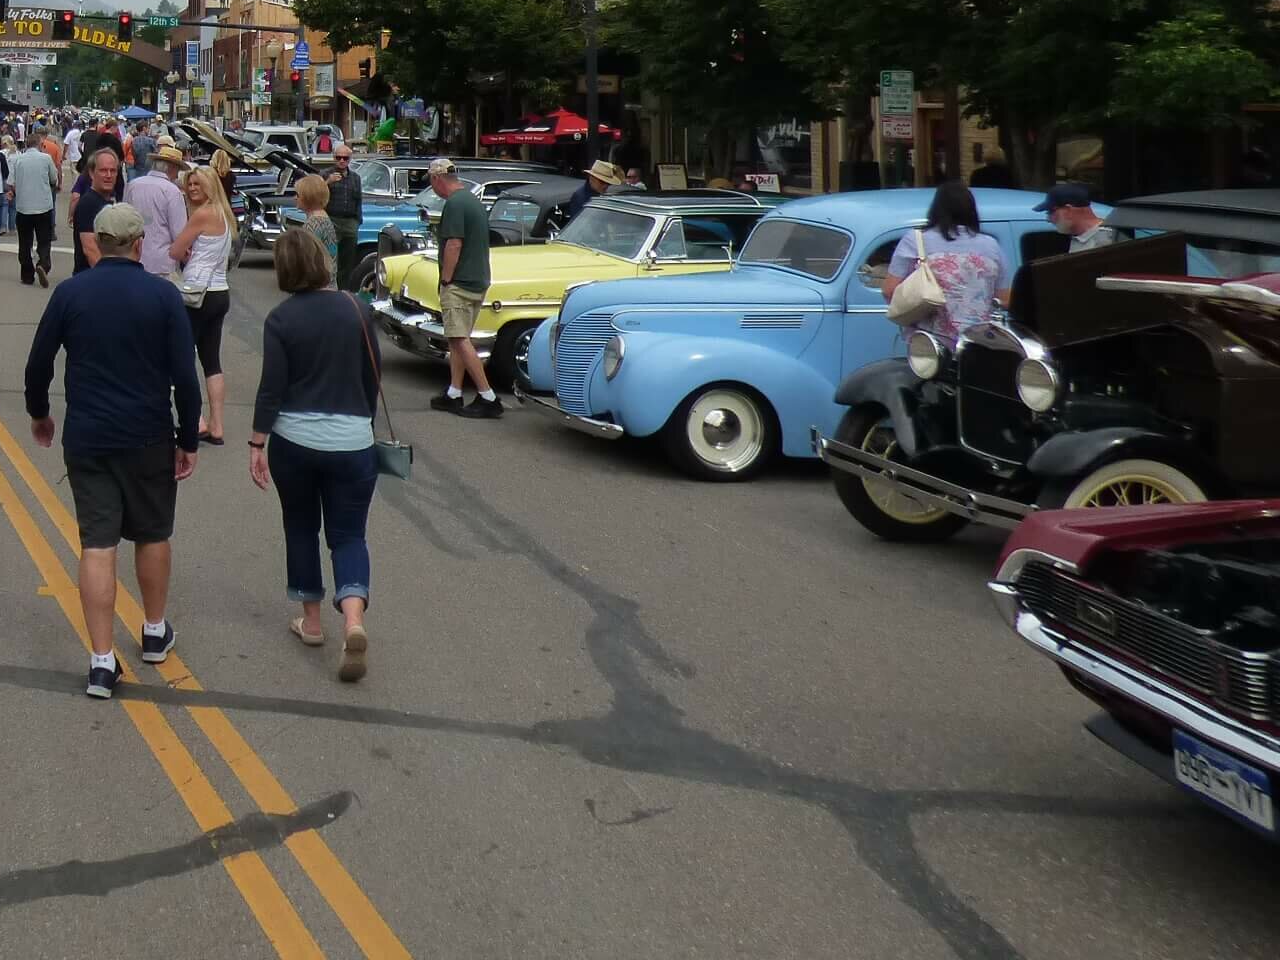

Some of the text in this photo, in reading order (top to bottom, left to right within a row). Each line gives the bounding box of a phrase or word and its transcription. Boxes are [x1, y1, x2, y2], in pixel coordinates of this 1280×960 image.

[149, 16, 179, 27] 12th St
[13, 20, 43, 36] TO
[43, 41, 68, 49] LIVES
